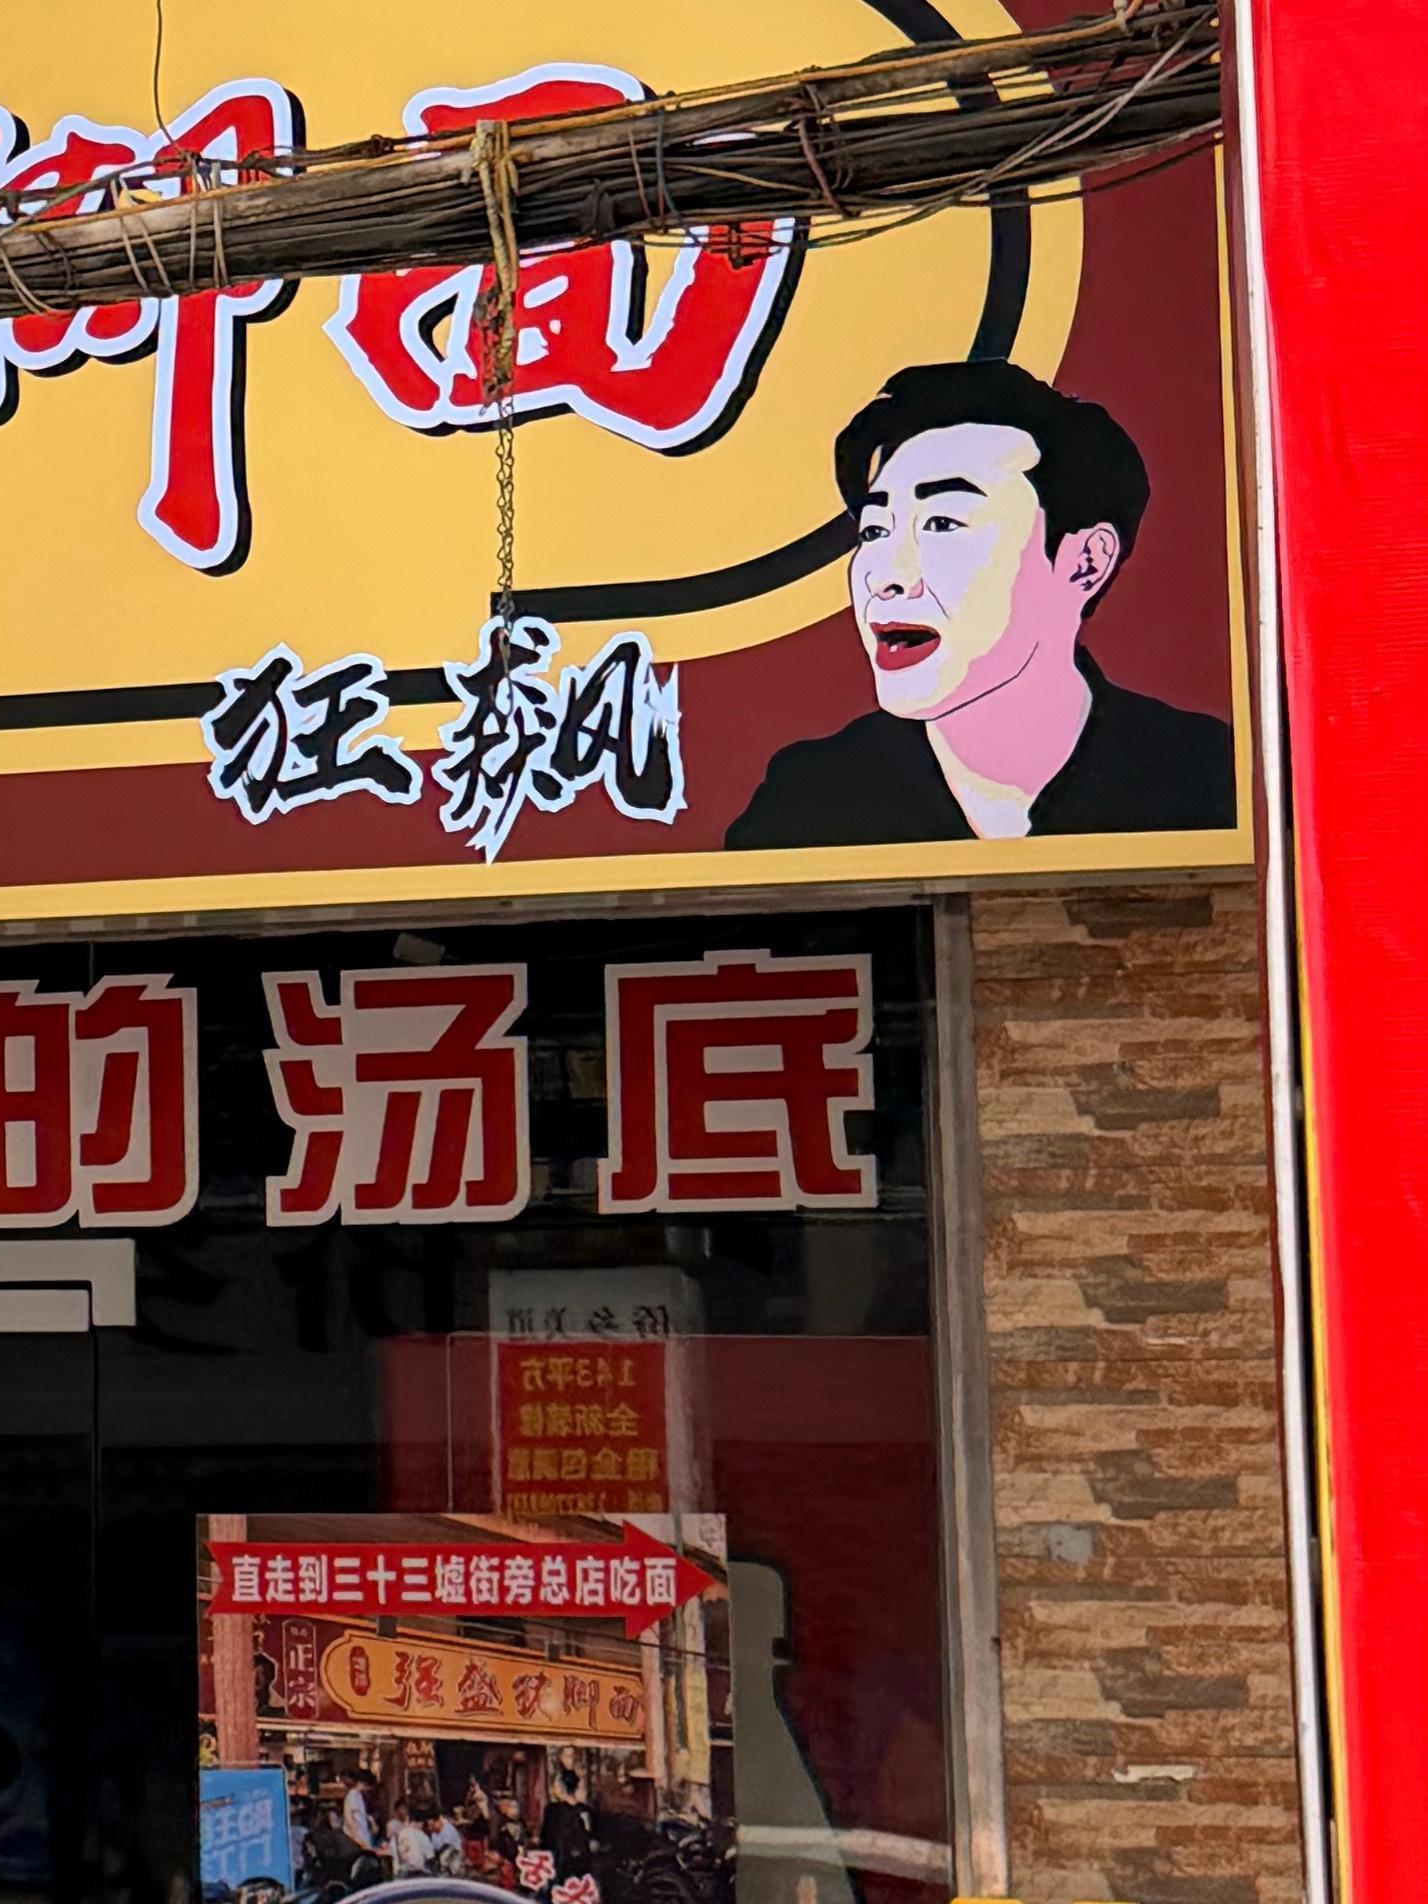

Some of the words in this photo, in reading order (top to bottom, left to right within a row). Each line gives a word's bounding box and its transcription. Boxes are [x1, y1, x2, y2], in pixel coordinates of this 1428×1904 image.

[200, 616, 687, 863] 狂飙
[231, 1553, 678, 1608] 直走到三十三墟街旁总店吃面
[288, 1642, 317, 1710] 正宗
